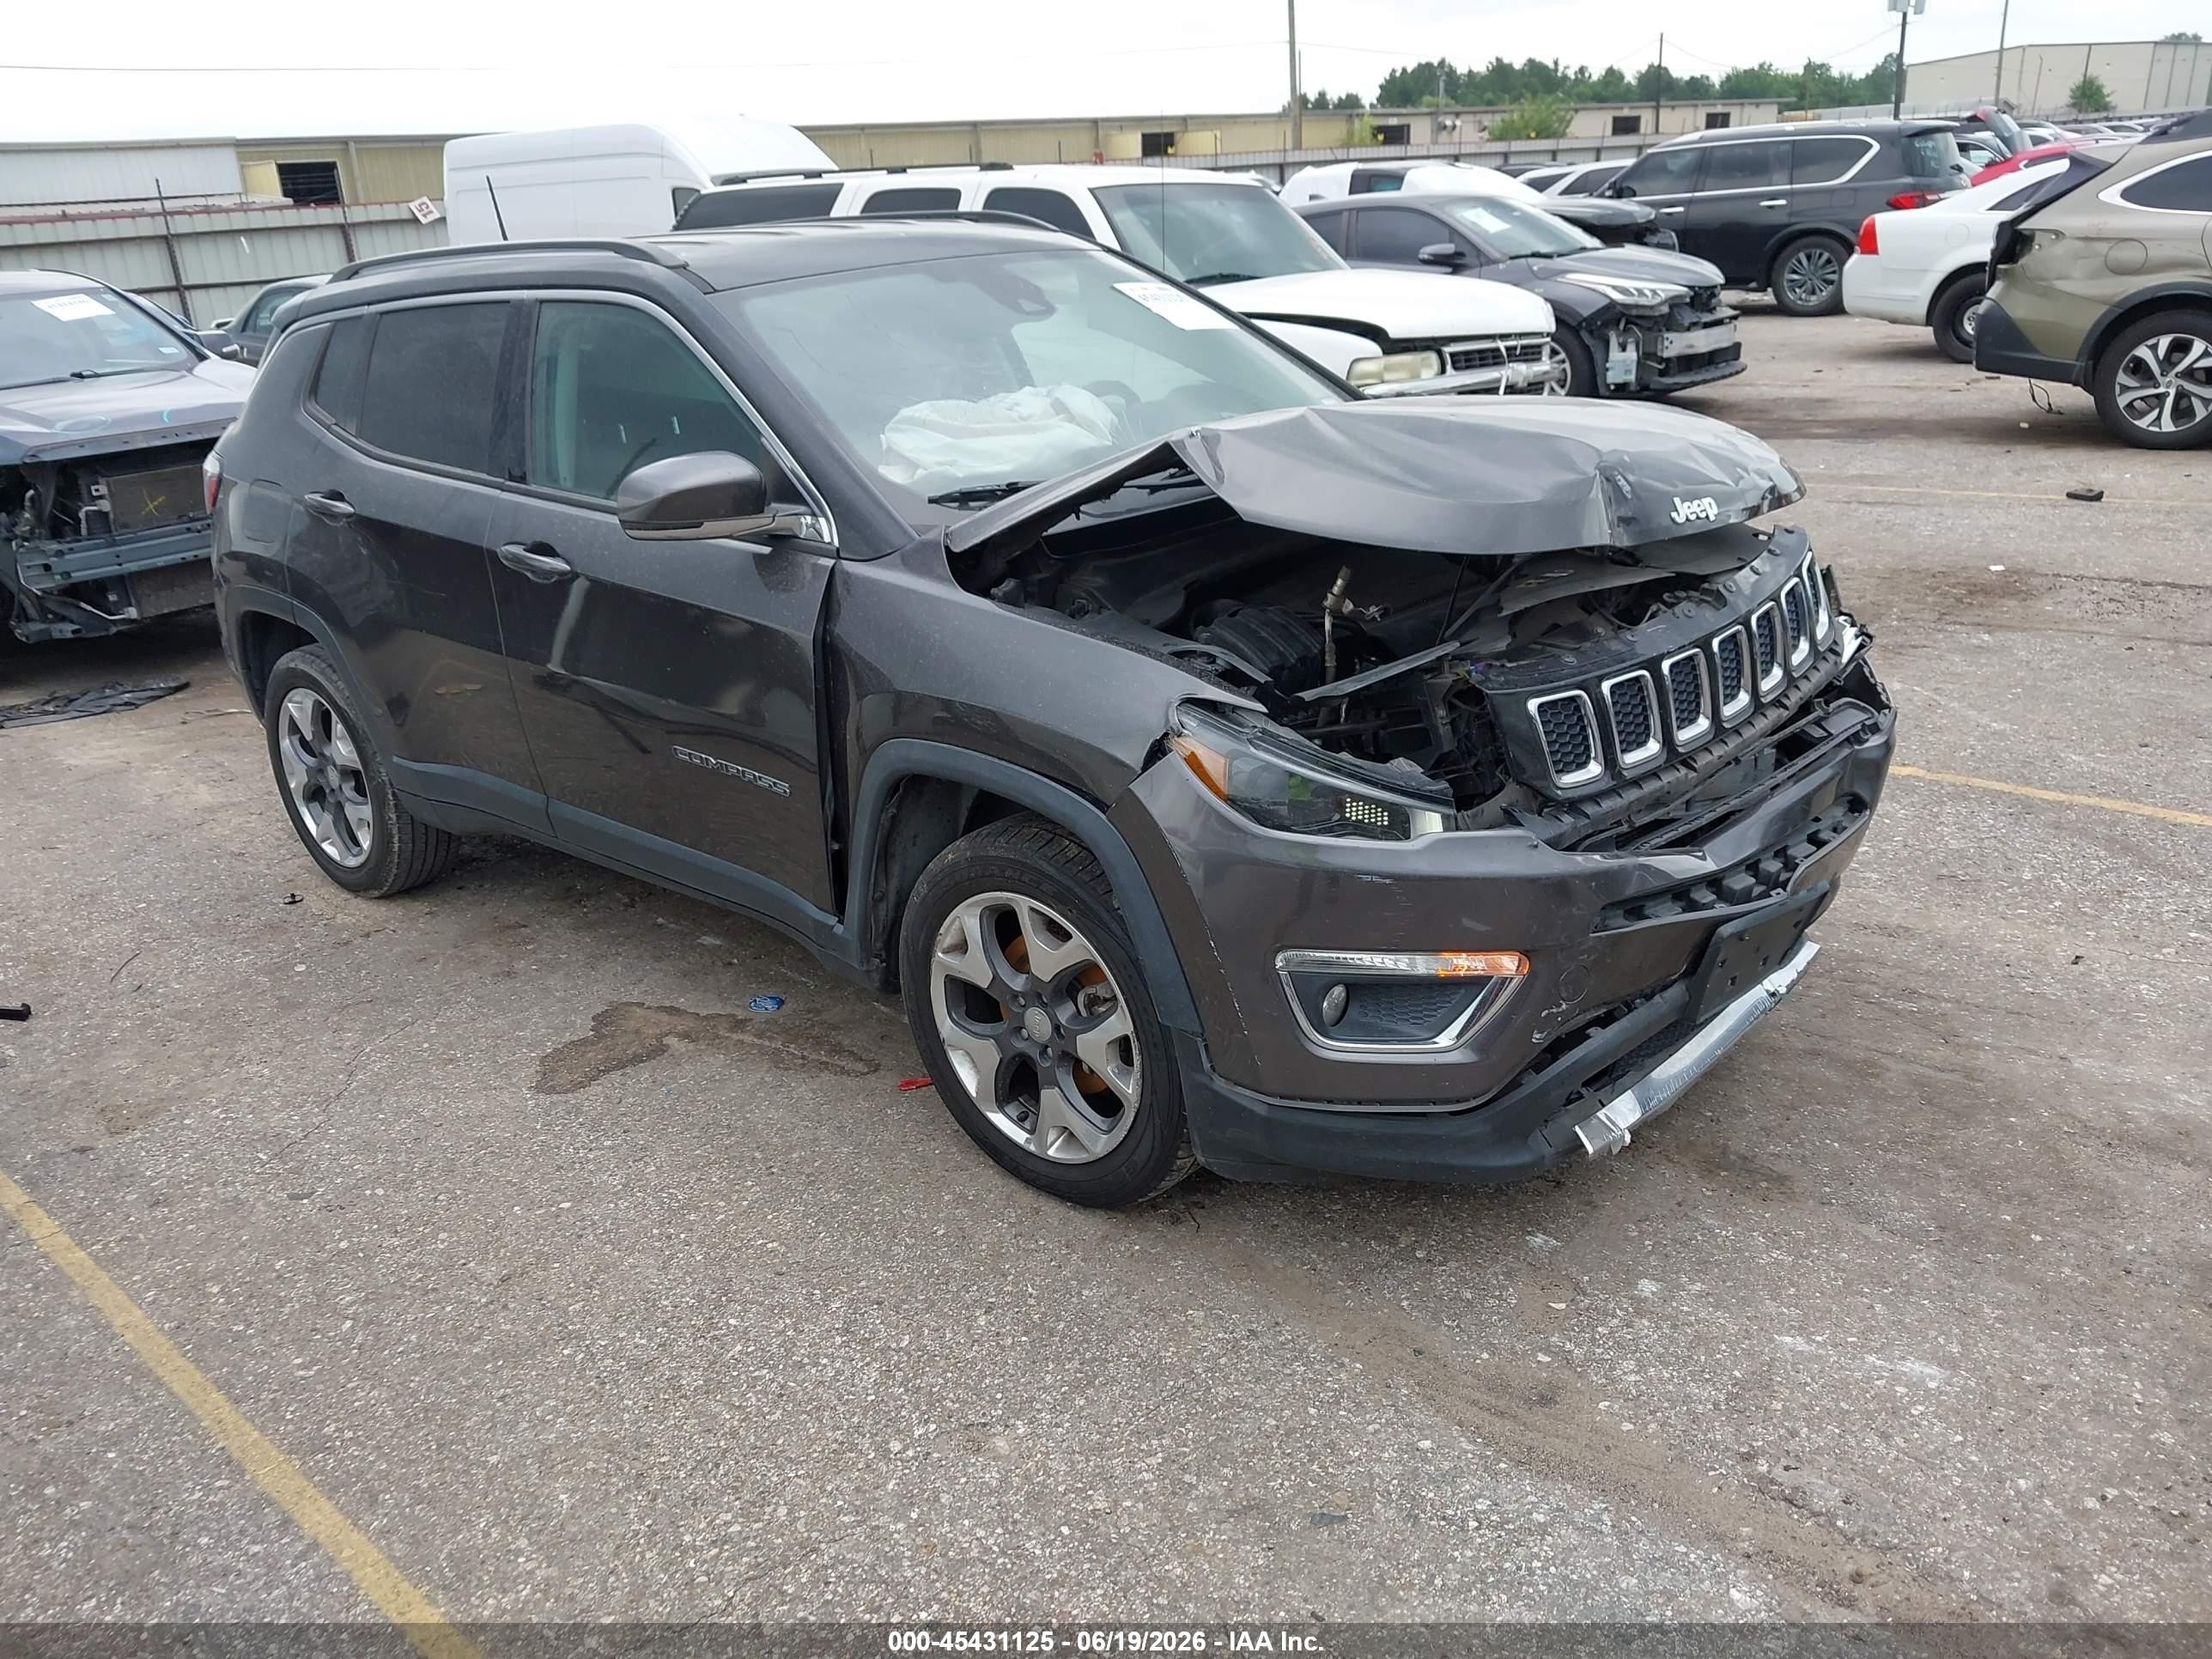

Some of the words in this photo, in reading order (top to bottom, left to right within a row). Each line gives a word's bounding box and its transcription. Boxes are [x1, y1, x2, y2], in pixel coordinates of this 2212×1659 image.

[415, 202, 434, 219] 15
[1669, 496, 1718, 524] Jeep
[672, 744, 791, 797] COMPASS
